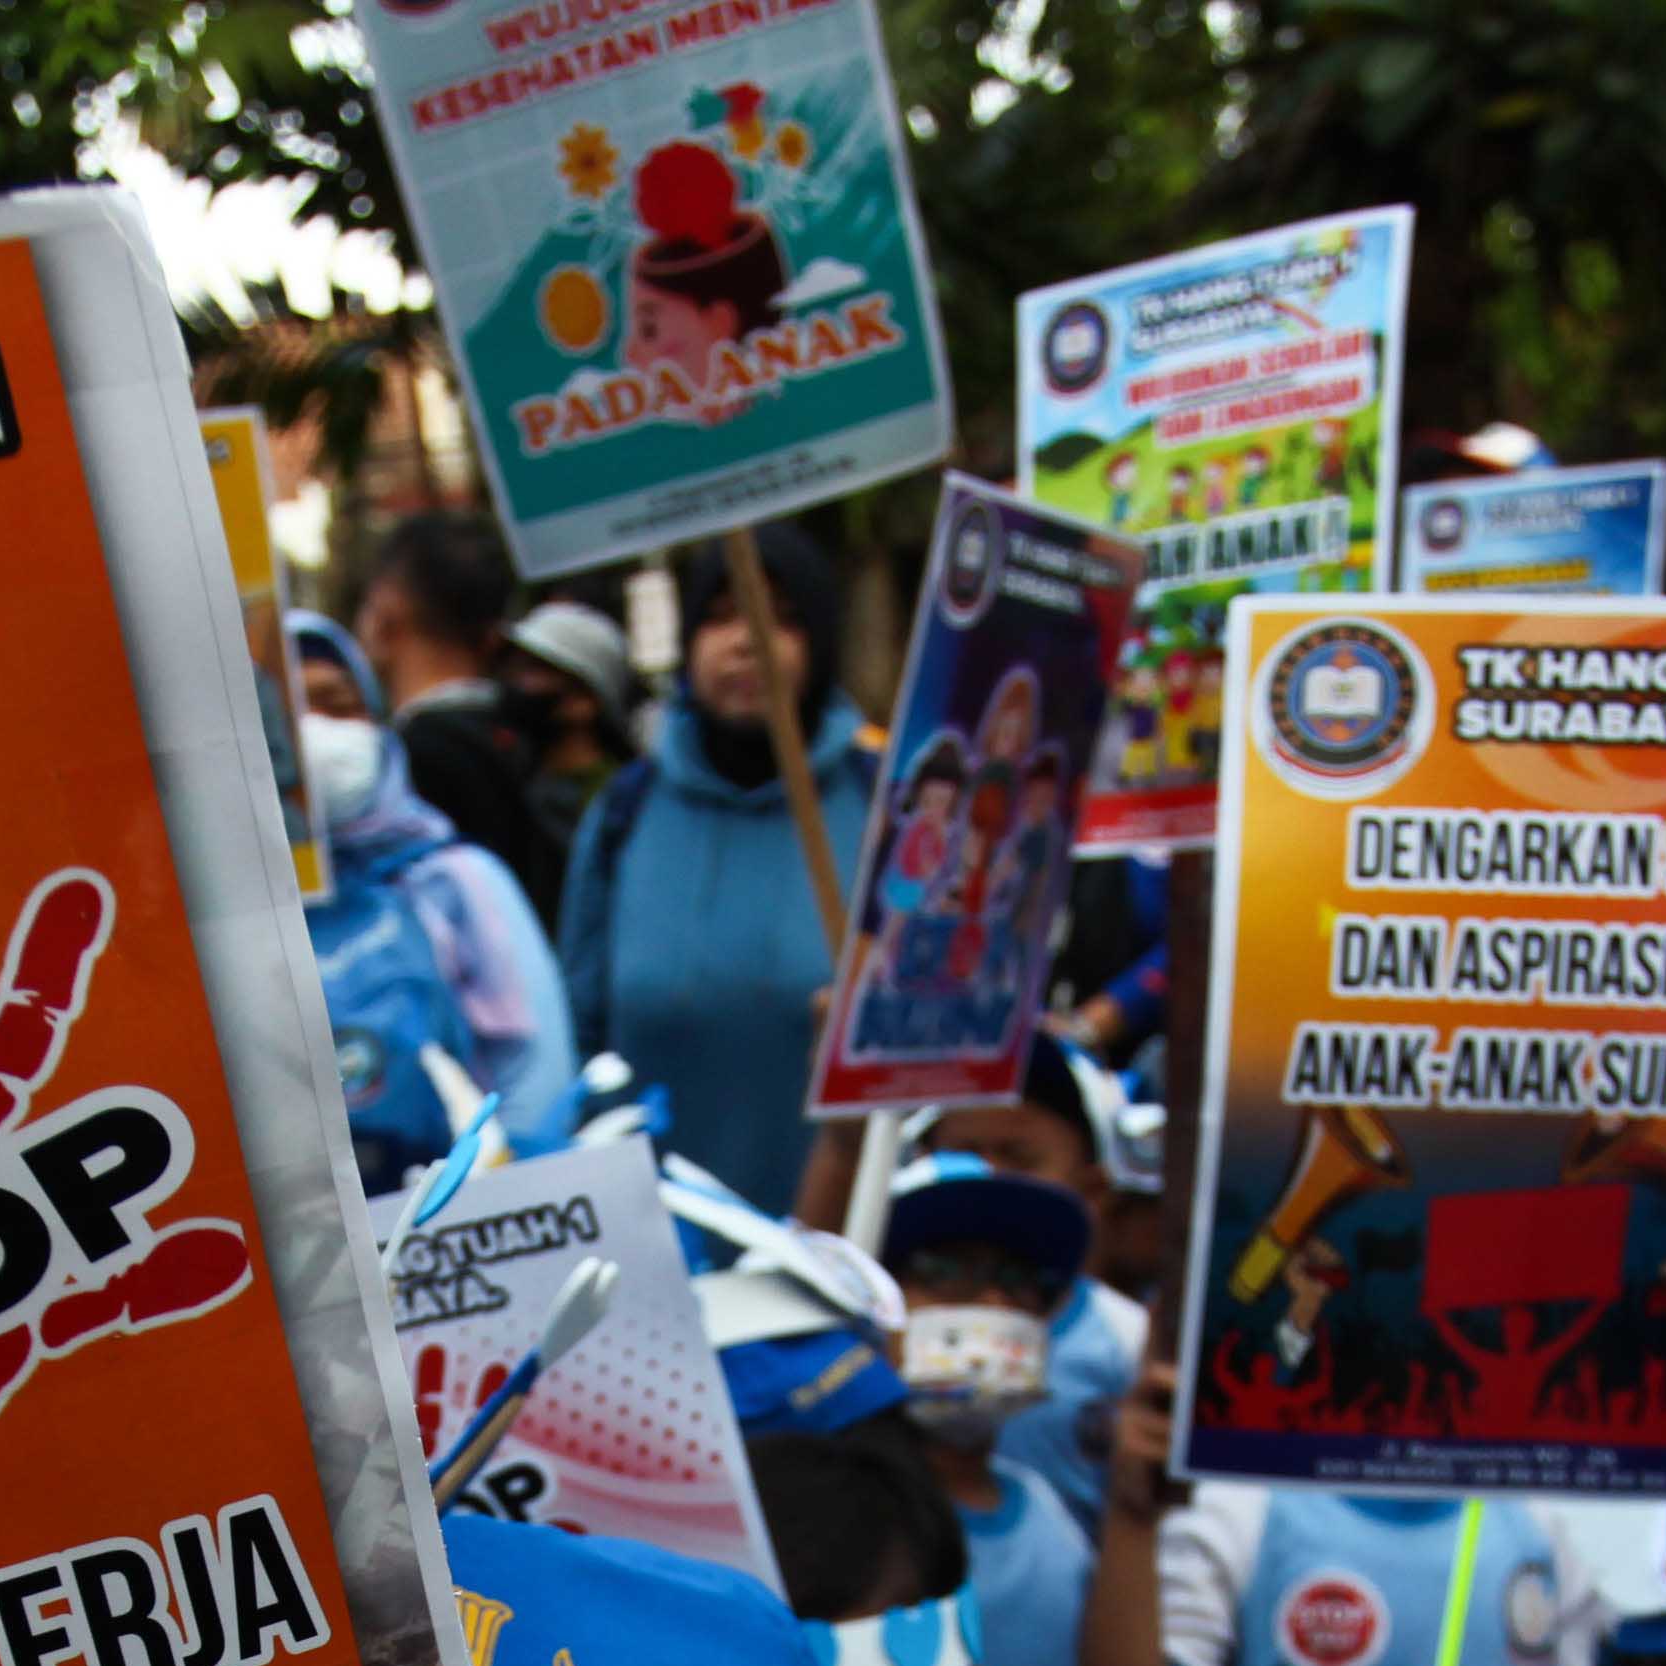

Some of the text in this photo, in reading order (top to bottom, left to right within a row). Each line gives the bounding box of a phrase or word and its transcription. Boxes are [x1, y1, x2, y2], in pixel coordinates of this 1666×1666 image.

[413, 27, 658, 128] KESEHATAN
[516, 296, 901, 450] PADA ANAK
[1459, 647, 1529, 689] TK
[1355, 816, 1655, 891] DENGARKAN
[1338, 923, 1444, 992] DAN
[1287, 1030, 1584, 1106] ANAK-ANAK
[443, 1203, 567, 1264] TUAH
[569, 1196, 600, 1243] 1
